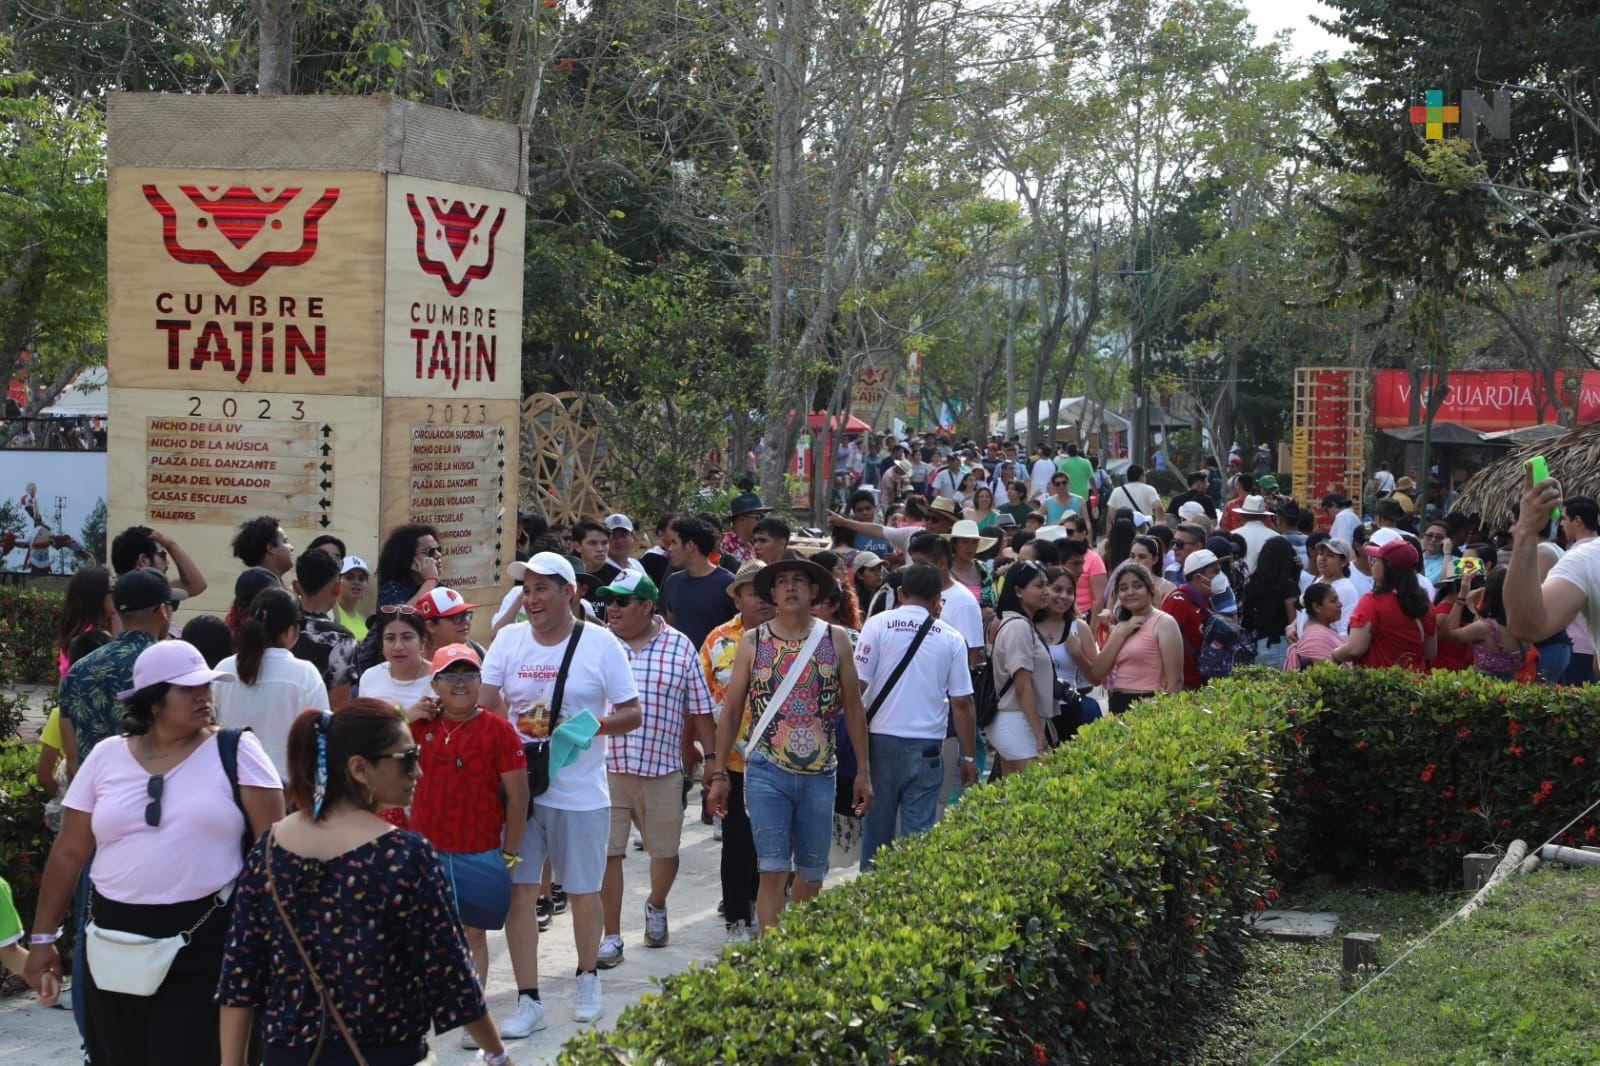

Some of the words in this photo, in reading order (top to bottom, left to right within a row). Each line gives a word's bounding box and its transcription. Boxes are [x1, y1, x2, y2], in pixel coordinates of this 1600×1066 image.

[156, 292, 324, 318] CUMBRE
[410, 302, 497, 328] CUMBRE
[1398, 385, 1533, 409] VGUARDIA
[189, 396, 305, 420] 2023
[427, 404, 488, 424] 2023
[151, 420, 187, 431] NICHO
[190, 422, 206, 432] DE
[208, 423, 225, 432] LA
[226, 424, 243, 433] UV
[151, 438, 187, 449] NICHO
[189, 439, 206, 449] DE
[208, 440, 223, 450] LA
[225, 439, 269, 451] MÚSICA
[413, 445, 433, 455] NICHO
[151, 456, 187, 466] PLAZA
[190, 457, 211, 468] DEL
[215, 458, 277, 470] DANZANTE
[413, 462, 433, 472] NICHO
[434, 462, 442, 471] DE
[443, 462, 451, 470] LA
[151, 474, 187, 485] PLAZA
[190, 475, 211, 486] DEL
[215, 477, 271, 488] VOLADOR
[412, 480, 433, 489] PLAZA
[434, 479, 446, 489] DEL
[447, 478, 478, 488] DANZANTE
[151, 491, 187, 502] CASAS
[190, 492, 247, 504] ESCUELAS
[412, 498, 433, 507] PLAZA
[434, 497, 445, 506] DEL
[447, 495, 475, 505] VOLADOR
[151, 510, 196, 520] TALLERES
[411, 514, 432, 524] CASAS
[434, 513, 463, 523] ESCUELAS
